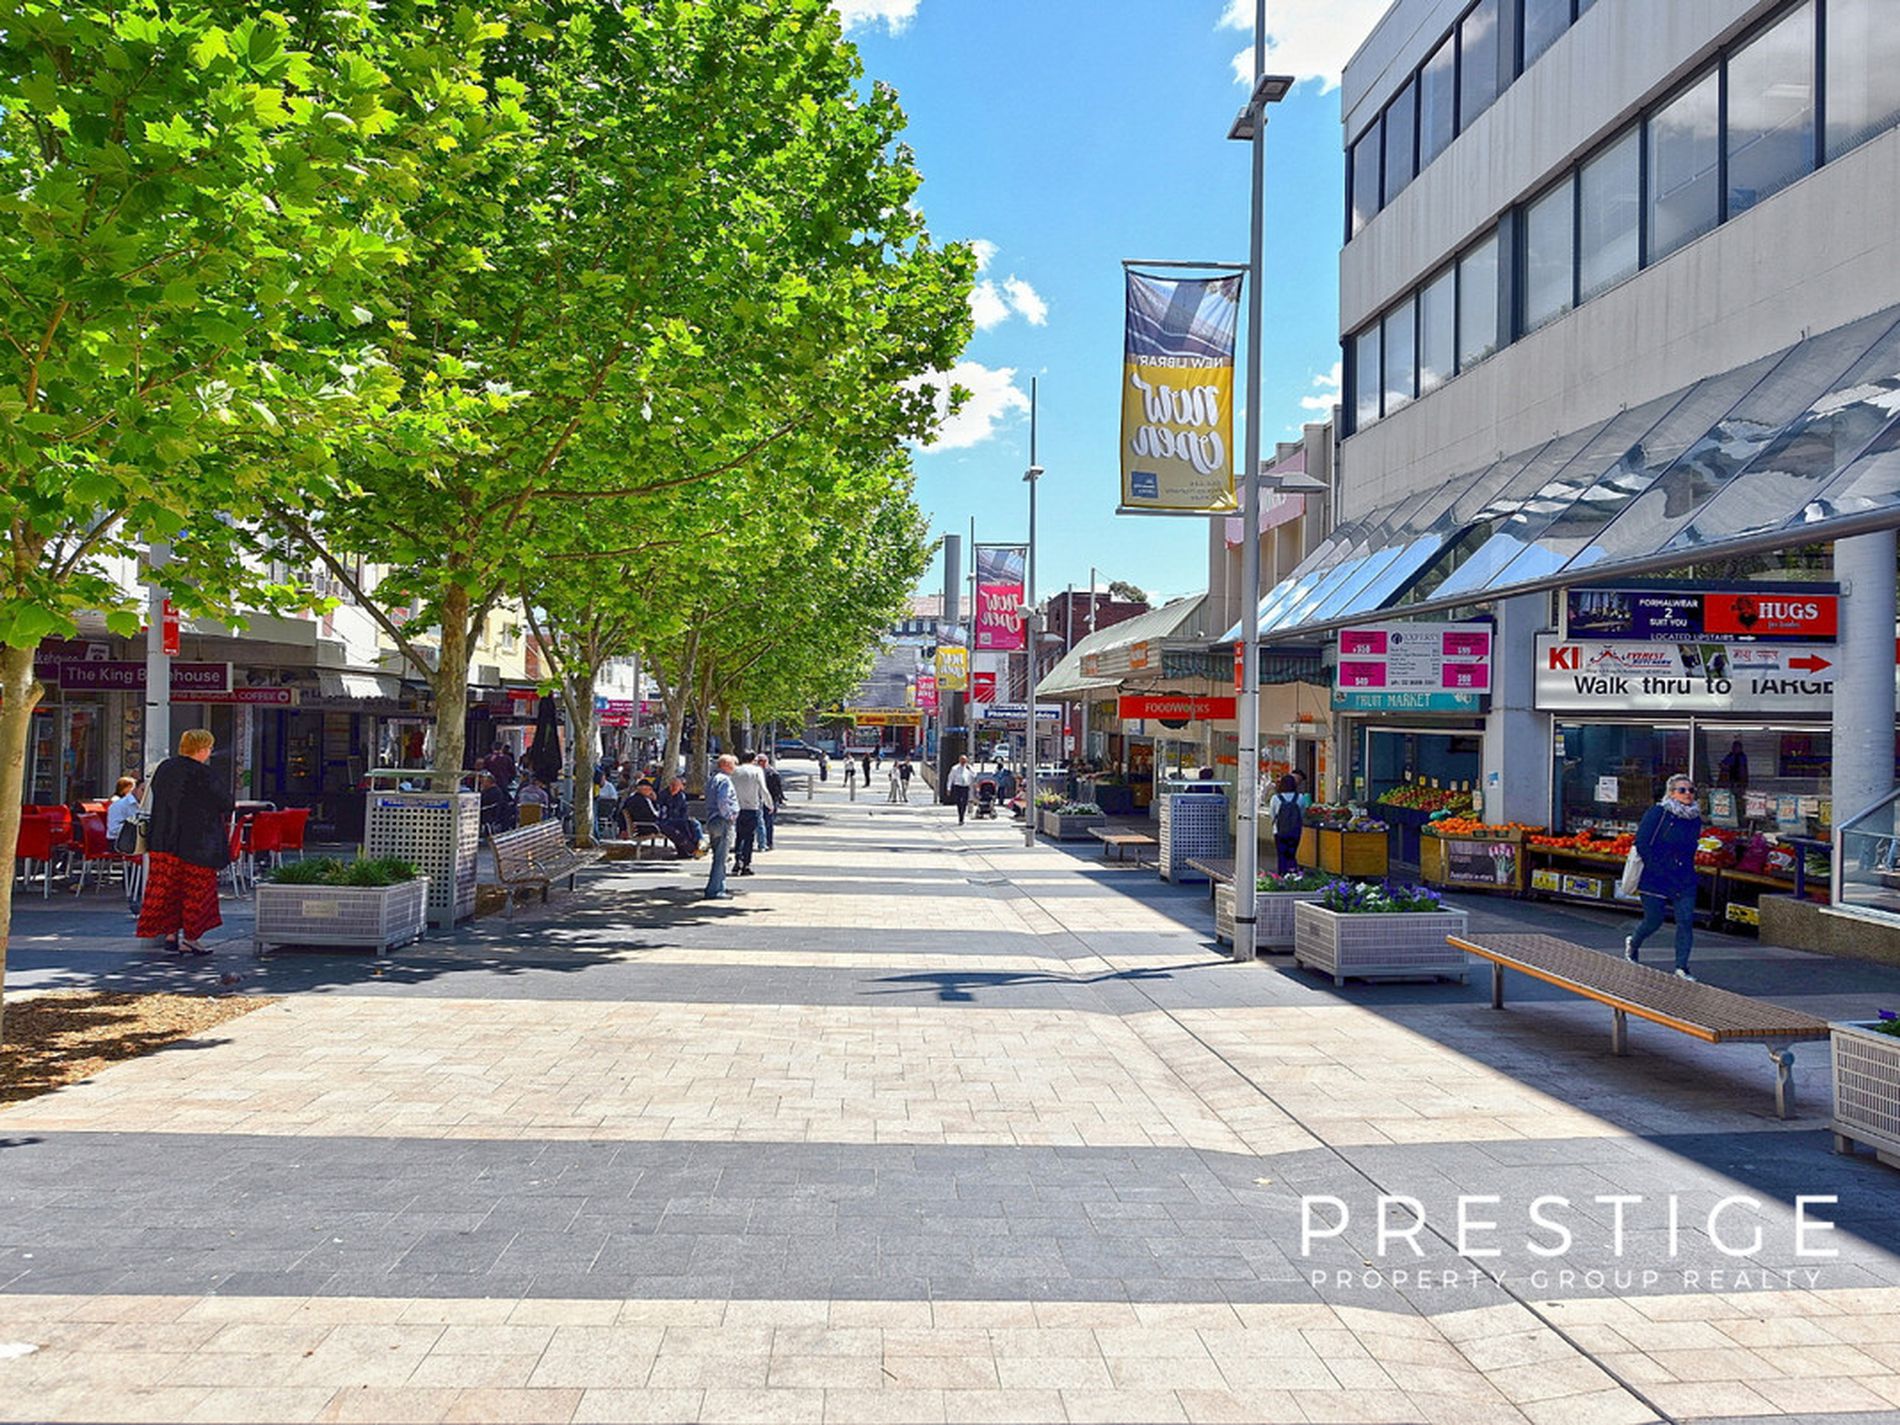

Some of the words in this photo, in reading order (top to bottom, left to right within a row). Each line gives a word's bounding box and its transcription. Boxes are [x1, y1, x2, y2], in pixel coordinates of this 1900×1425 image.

[1639, 599, 1698, 608] FORMALWEAR
[1664, 608, 1673, 618] 2
[1758, 602, 1819, 619] HUGS
[1649, 618, 1668, 626] SUIT
[1670, 618, 1687, 627] YOU
[1650, 633, 1692, 641] LOCATED
[1693, 633, 1735, 641] UPSTAIRS
[67, 666, 96, 680] The
[100, 666, 133, 684] King
[137, 666, 220, 681] Behouse
[1574, 675, 1628, 694] Walk
[1642, 676, 1691, 694] thru
[1706, 678, 1731, 694] to
[238, 691, 277, 701] COFFEE
[1355, 694, 1382, 707] FRUIT
[1387, 693, 1431, 707] MARKET
